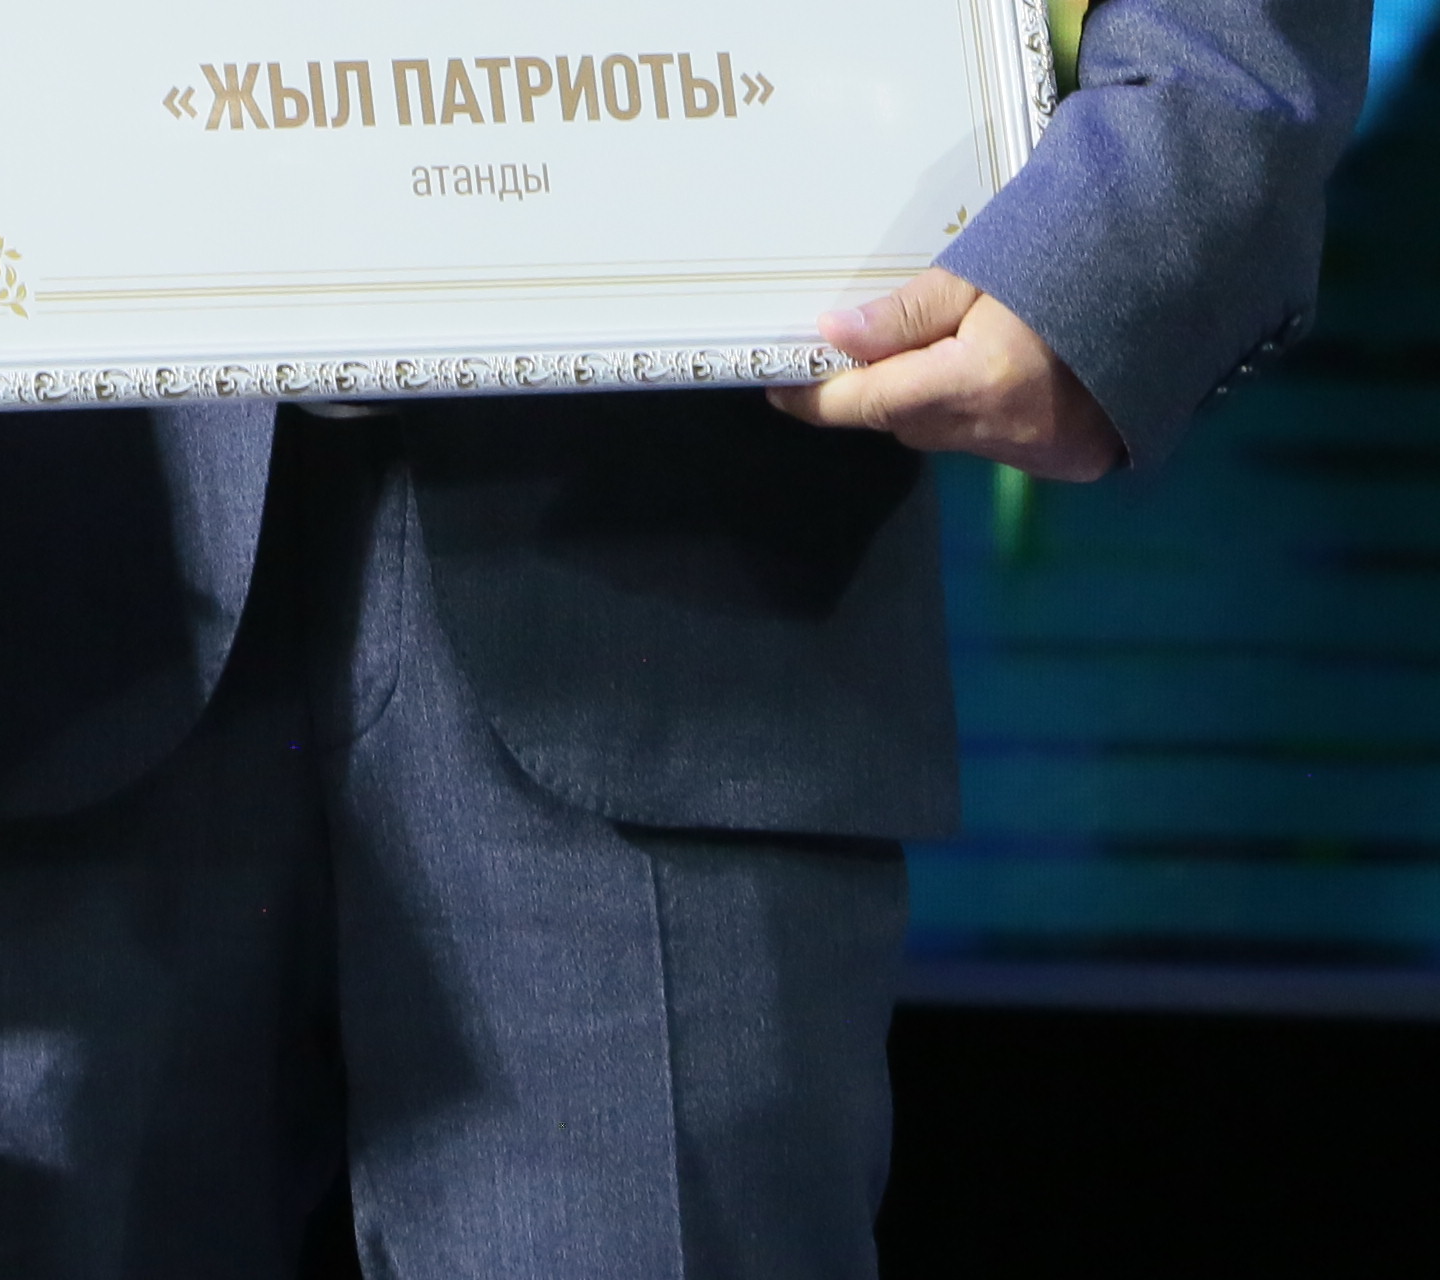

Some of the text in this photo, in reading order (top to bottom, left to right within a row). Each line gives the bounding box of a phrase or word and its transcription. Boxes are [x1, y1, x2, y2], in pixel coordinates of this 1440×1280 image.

[163, 51, 774, 131] «ЖЫЛ ПАТРИОТЫ»
[412, 163, 550, 202] атанды
